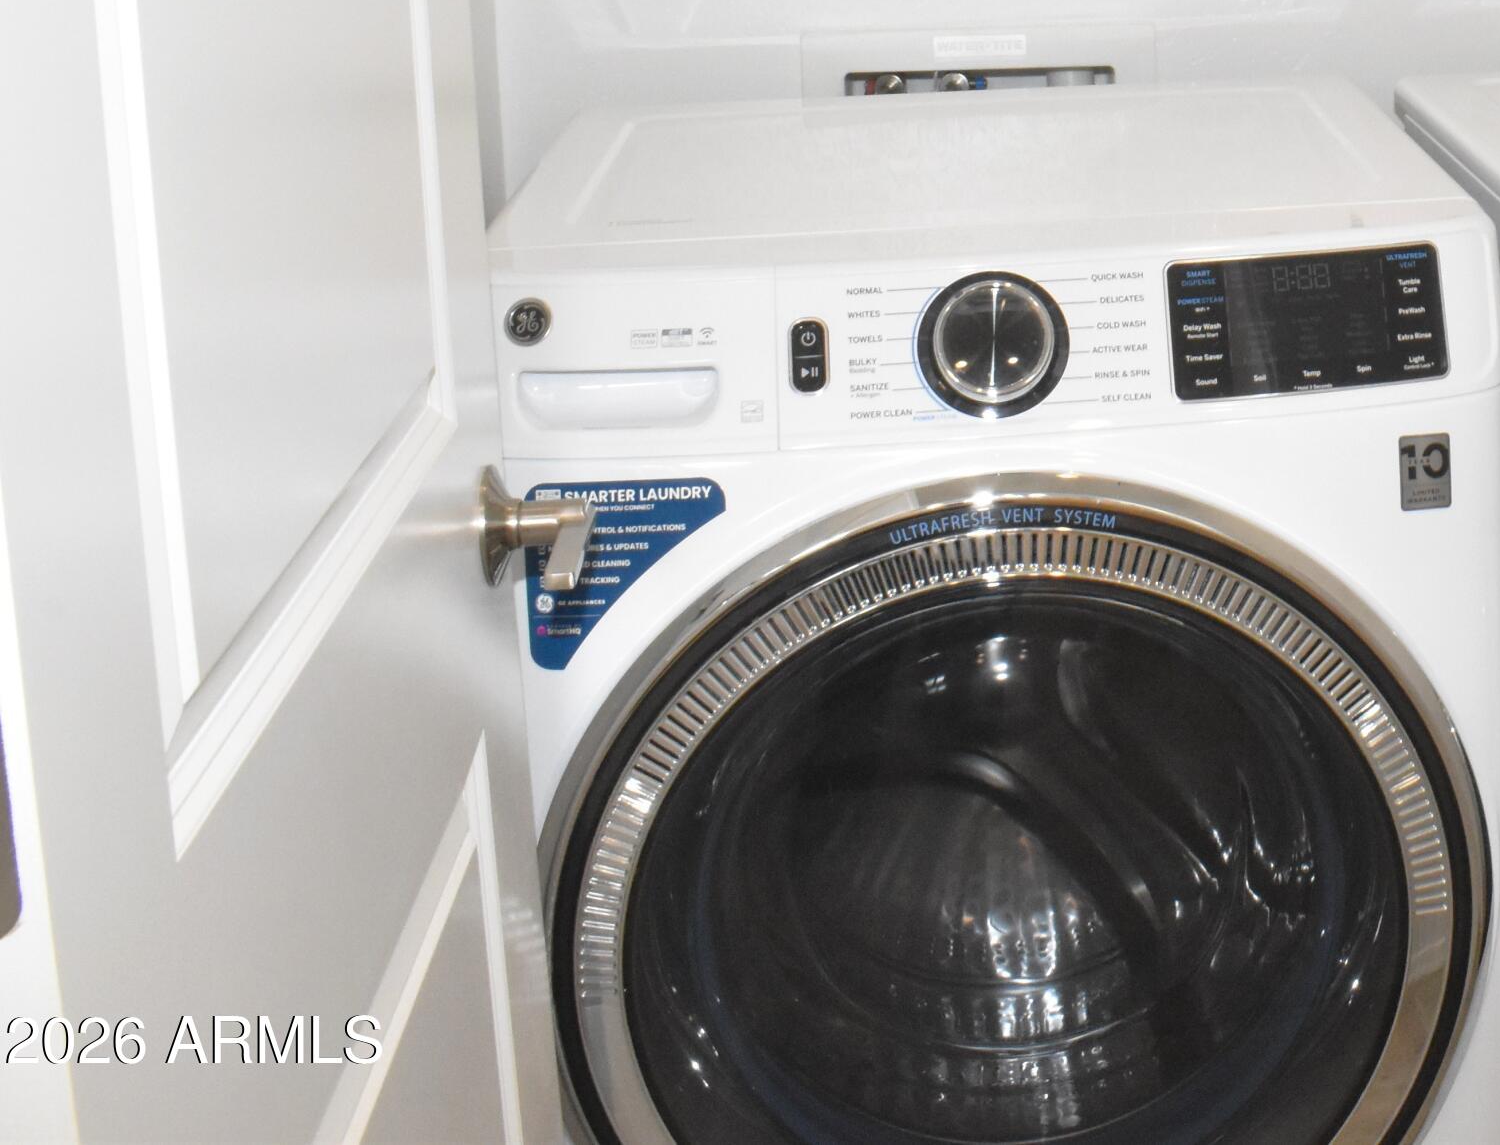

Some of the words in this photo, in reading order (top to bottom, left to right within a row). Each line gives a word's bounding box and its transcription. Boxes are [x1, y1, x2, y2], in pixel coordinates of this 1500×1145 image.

[1091, 273, 1117, 282] QUICK
[1119, 271, 1144, 280] WASH
[1186, 270, 1212, 278] SMART
[1181, 278, 1217, 286] DISPENSE
[1398, 278, 1421, 286] Tumble
[846, 287, 883, 295] NORMAL
[1100, 295, 1145, 304] DELICATES
[848, 310, 881, 319] WHITES
[1097, 320, 1120, 329] COLD
[1121, 318, 1147, 328] WASH
[1183, 324, 1202, 332] Delay
[1203, 322, 1222, 330] Wash
[848, 335, 883, 344] TOWELS
[1397, 333, 1414, 341] Extra
[1092, 345, 1122, 354] ACTIVE
[1123, 343, 1148, 352] WEAR
[1203, 353, 1223, 361] Saver
[1408, 355, 1425, 364] Light
[848, 358, 877, 367] BULKY
[1095, 370, 1120, 379] RINSE
[1121, 370, 1128, 378] &
[1130, 369, 1151, 377] SPIN
[1195, 378, 1218, 386] Sound
[1253, 374, 1267, 382] Soil
[1356, 365, 1372, 373] Spin
[850, 383, 889, 392] SANITIZE
[1102, 395, 1121, 403] SELF
[1123, 392, 1152, 402] CLEAN
[850, 411, 881, 420] POWER
[883, 409, 913, 418] CLEAN
[1401, 442, 1450, 480] 10
[640, 485, 712, 501] LAUNDRY
[624, 503, 655, 511] CONNECT
[625, 523, 687, 533] NOTIFICATIONS
[890, 511, 993, 546] ULTRAFRESH
[1002, 507, 1045, 523] VENT
[1054, 509, 1117, 529] SYSTEM
[605, 543, 612, 551] &
[613, 542, 649, 551] UPDATES
[592, 559, 631, 568] CLEANING
[580, 576, 620, 585] TRACKING
